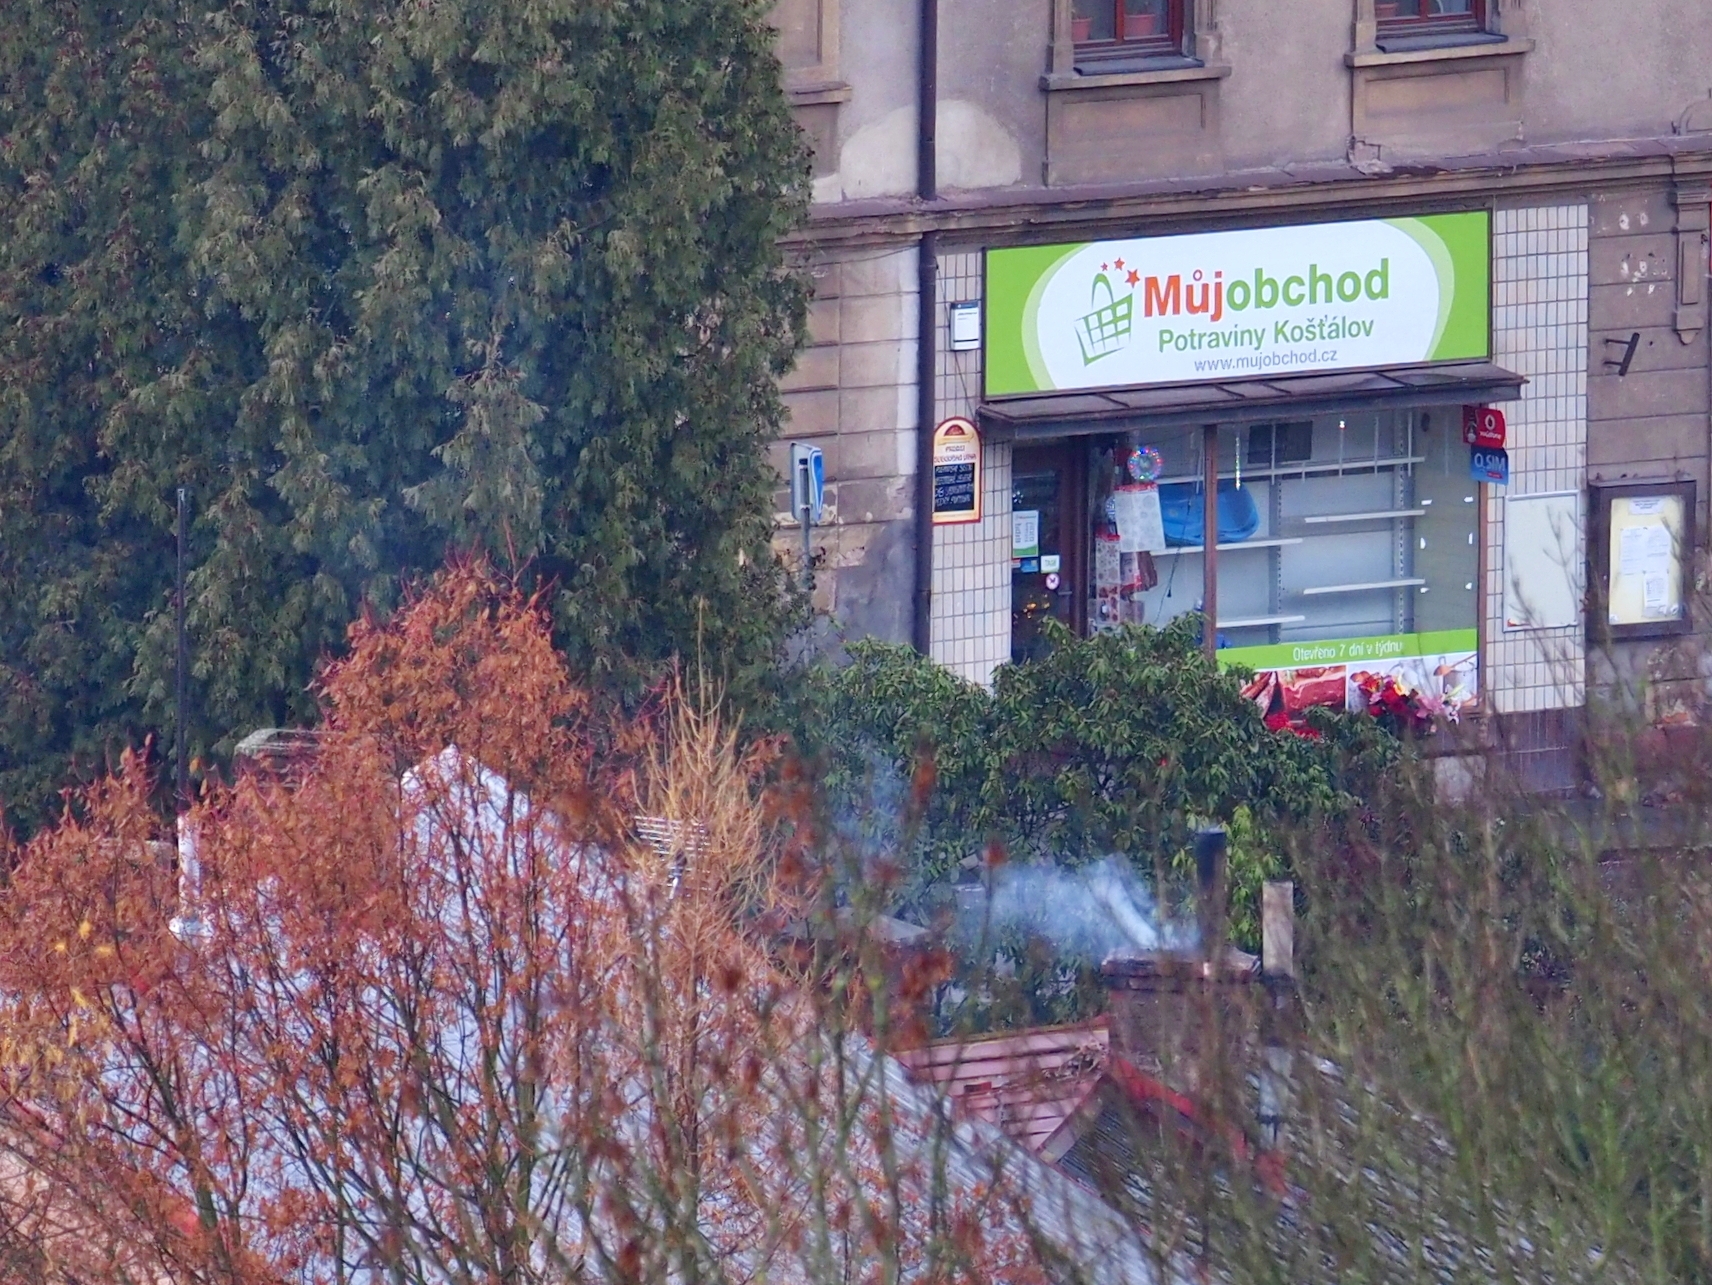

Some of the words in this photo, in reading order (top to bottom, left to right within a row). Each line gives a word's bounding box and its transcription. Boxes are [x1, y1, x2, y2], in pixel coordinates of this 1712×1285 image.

[1144, 257, 1389, 322] Můjobchod
[1159, 323, 1266, 353] Potraviny
[1274, 314, 1374, 345] Košťálov
[1194, 349, 1338, 372] www.mujobchod.cz
[1293, 646, 1336, 662] Otevřeno
[1339, 644, 1346, 657] 7
[1348, 642, 1364, 657] dní
[1366, 644, 1373, 655] v
[1375, 640, 1402, 657] týdnu
